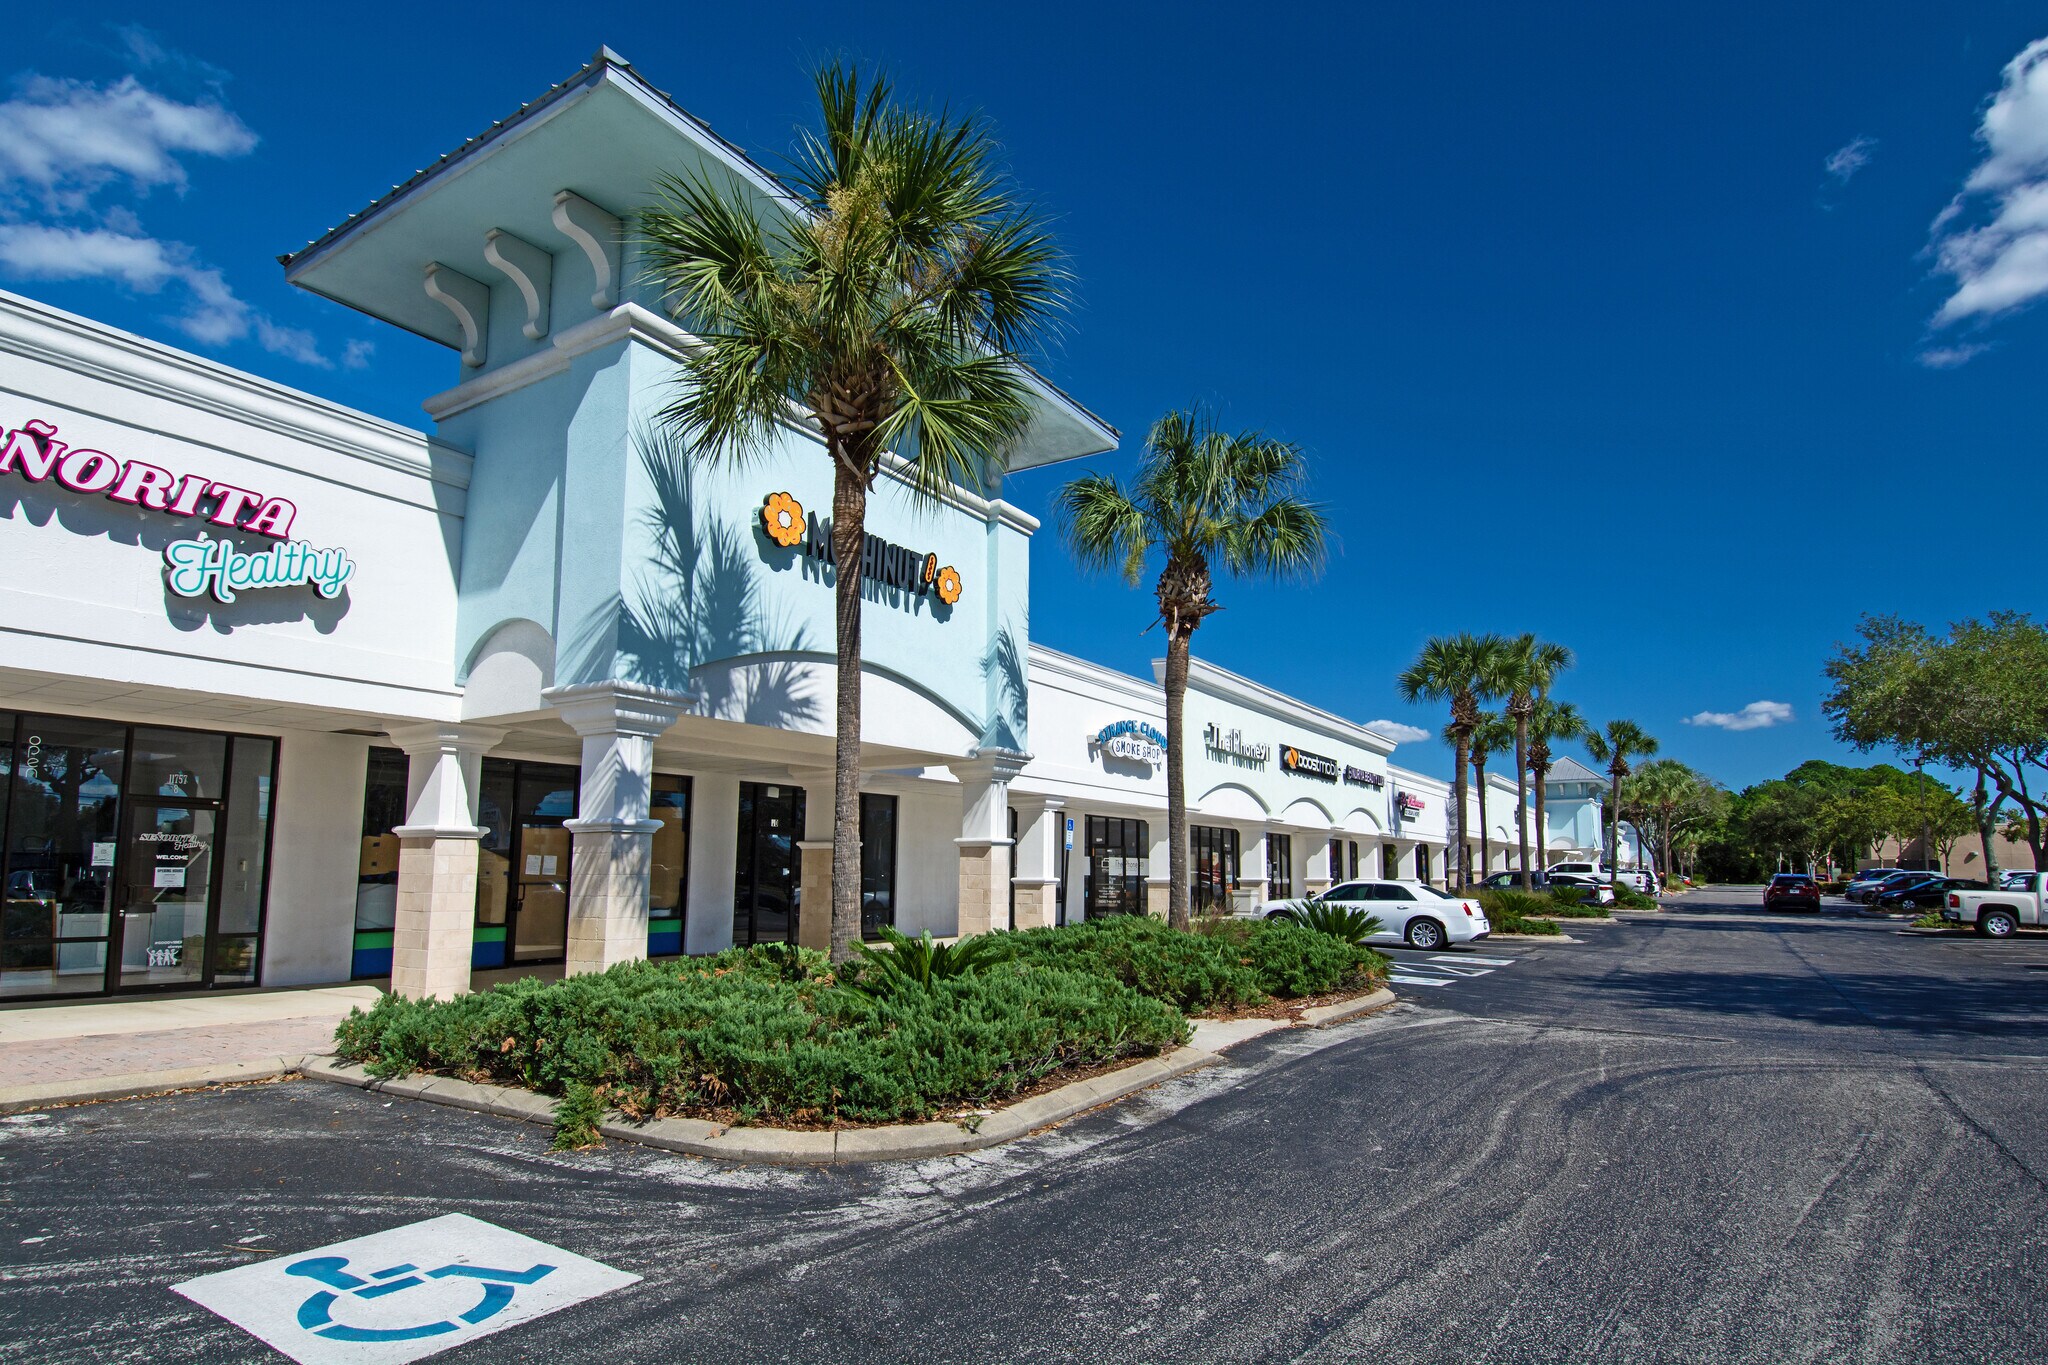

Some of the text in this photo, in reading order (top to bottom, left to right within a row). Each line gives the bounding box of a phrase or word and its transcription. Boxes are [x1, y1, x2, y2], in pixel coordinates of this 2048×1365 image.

[0, 419, 297, 538] ÑORITA
[168, 541, 355, 602] Healthy
[806, 510, 924, 593] MHINUT
[1098, 719, 1138, 745] STRANGE
[1115, 740, 1161, 760] SMOKE SHOP
[169, 774, 188, 785] 11757
